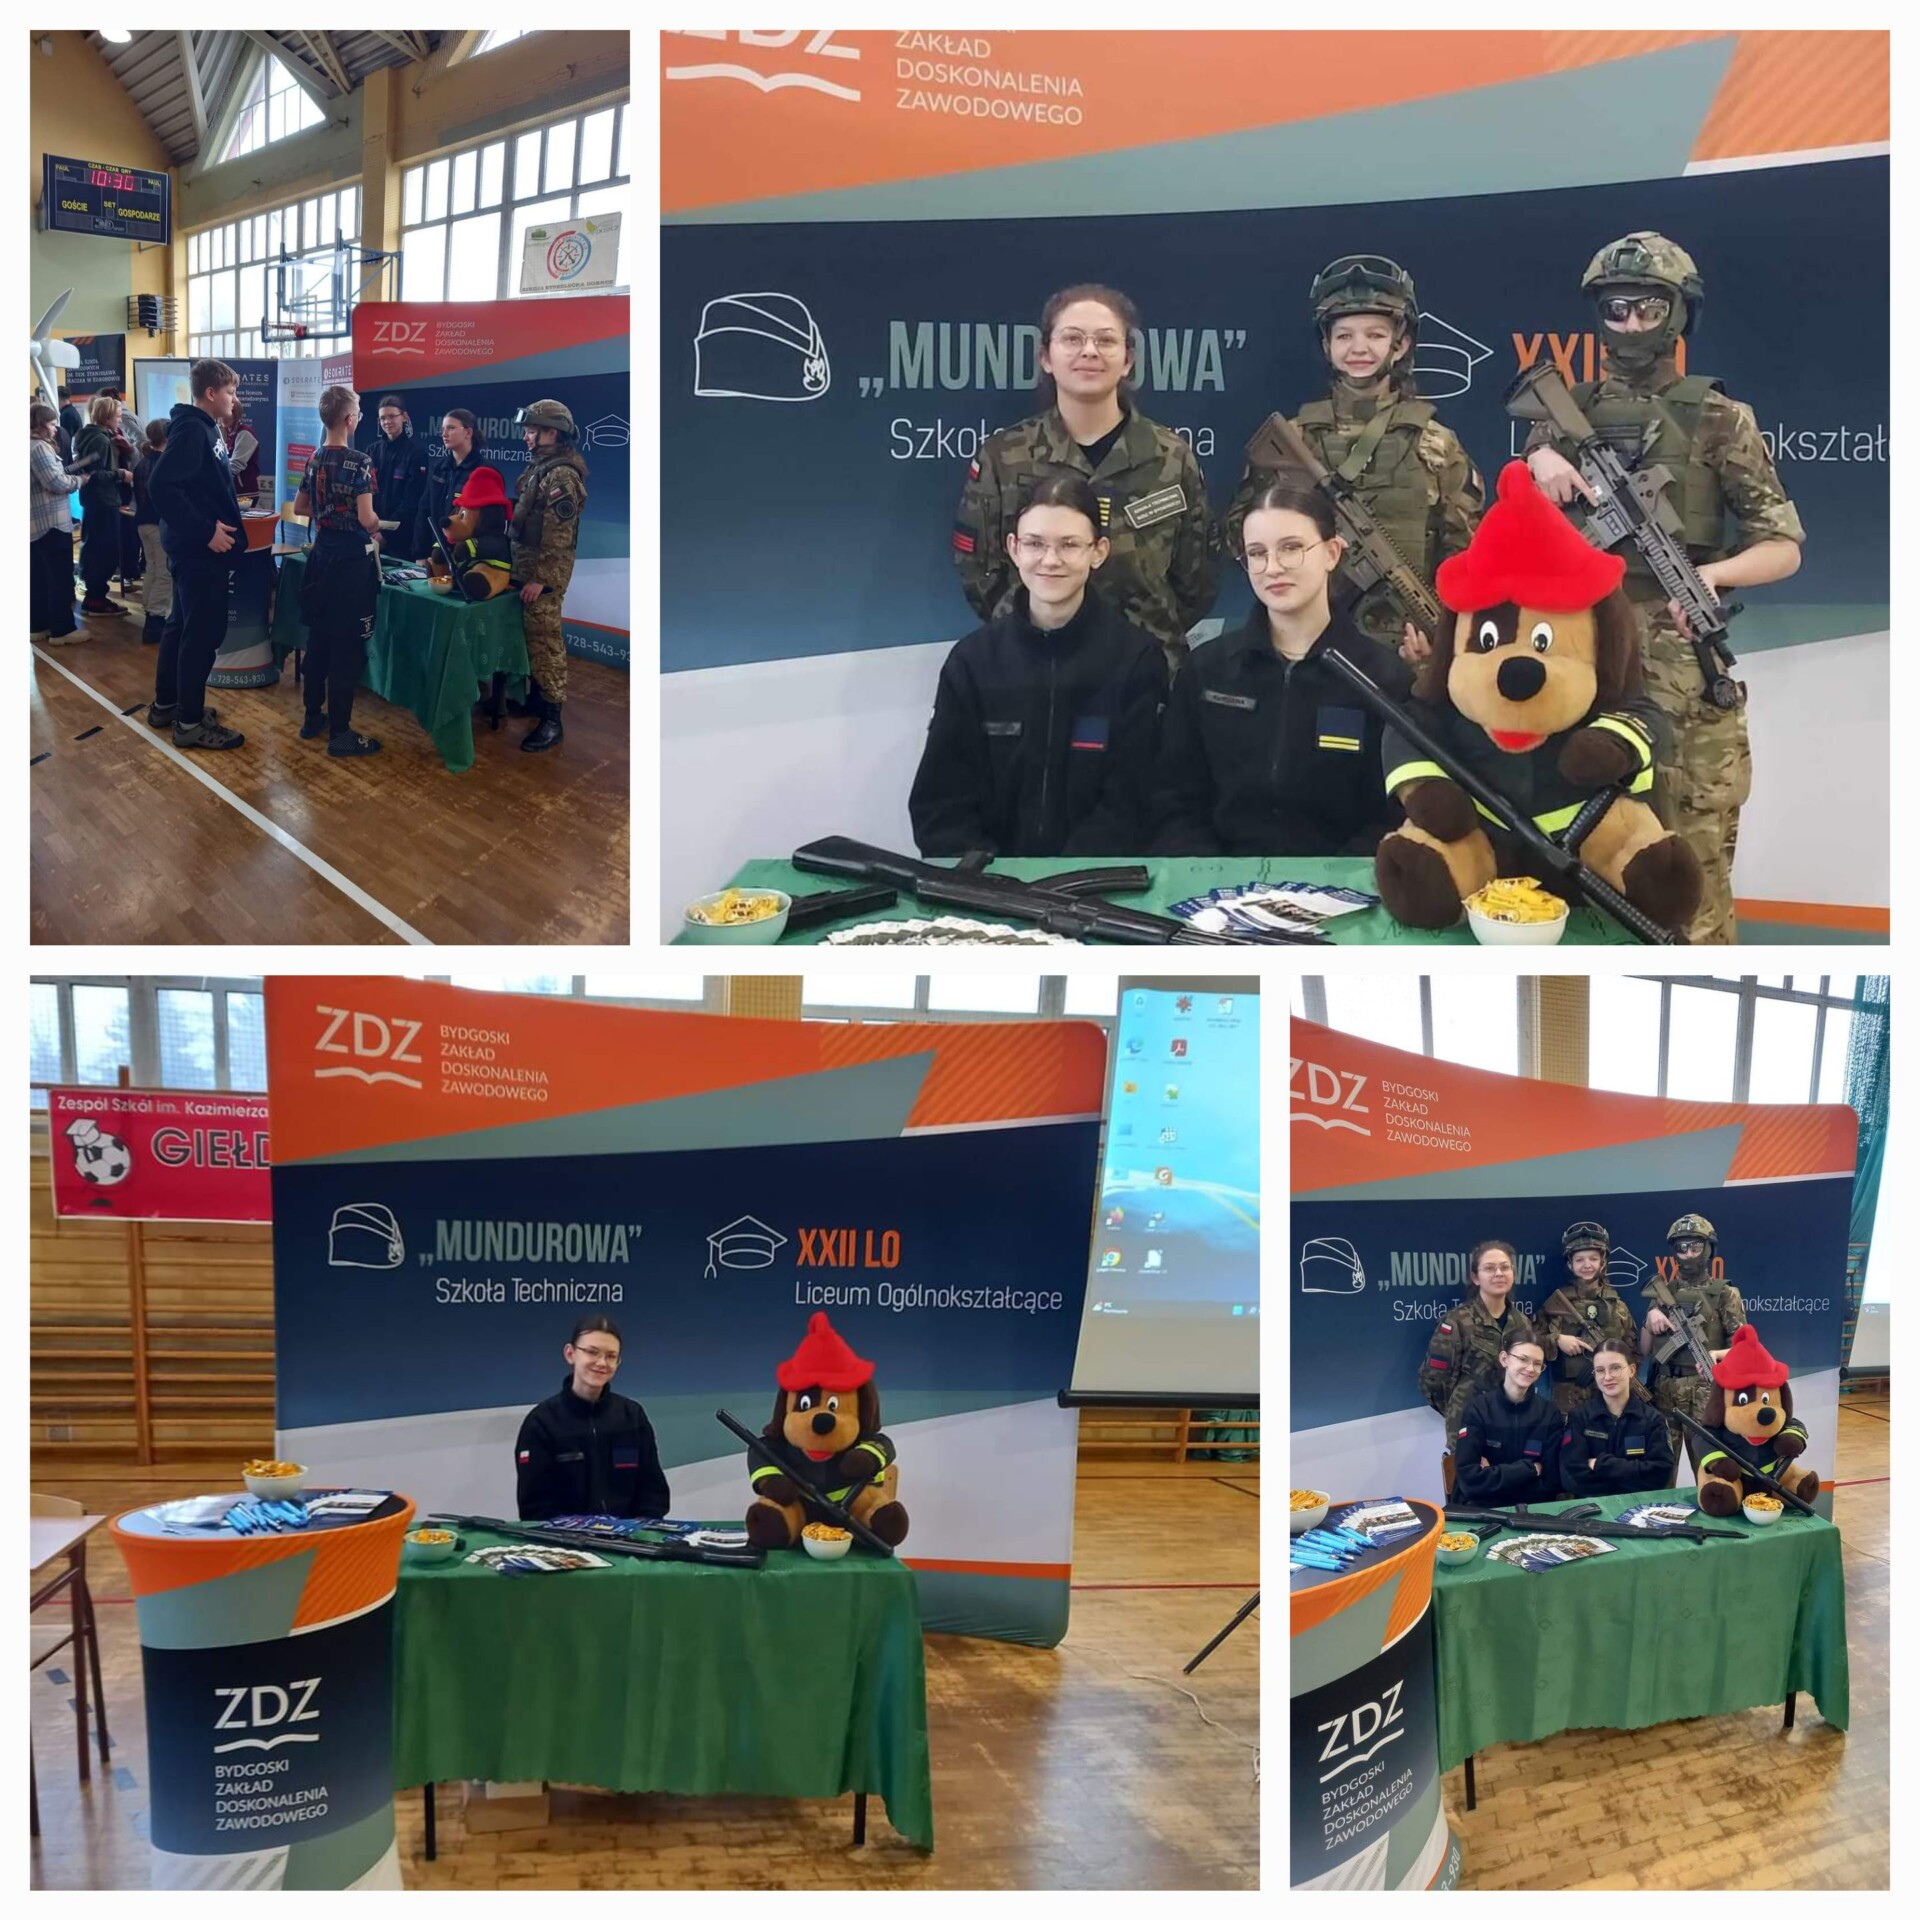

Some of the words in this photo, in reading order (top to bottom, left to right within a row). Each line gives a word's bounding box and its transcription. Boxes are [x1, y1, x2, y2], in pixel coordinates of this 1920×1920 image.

[895, 30, 991, 59] ZAKŁAD
[896, 58, 1083, 97] DOSKONALENIA
[896, 88, 1083, 126] ZAWODOWEGO
[91, 170, 134, 191] 10:30
[61, 199, 88, 212] GOŚCIE
[118, 208, 161, 221] GOSPODARZE
[373, 321, 428, 343] ZDZ
[436, 321, 475, 329] BYDGOSKI
[434, 347, 494, 355] ZAWODOWEGO
[435, 338, 495, 346] DOSKONALENIA
[858, 320, 1247, 399] „MUNDWA”
[1511, 333, 1608, 391] XXI
[238, 374, 269, 382] ATES
[889, 418, 1003, 460] Szkoł
[480, 447, 532, 462] chniczna
[218, 674, 266, 684] 728-543-930
[314, 1004, 423, 1064] ZDZ
[440, 1025, 510, 1046] BYDGOSKI
[440, 1043, 496, 1061] ZAKŁAD
[441, 1061, 549, 1085] DOSKONALENIA
[1290, 1056, 1369, 1114] ZDZ
[441, 1079, 548, 1102] ZAWODOWEGO
[1382, 1080, 1439, 1103] BYDGOSKI
[156, 1100, 180, 1114] im.
[185, 1101, 269, 1119] Kazimierza
[1383, 1096, 1429, 1115] ZAKŁAD
[1385, 1112, 1471, 1137] DOSKONALENIA
[152, 1127, 270, 1170] GIEŁD
[1386, 1129, 1472, 1152] ZAWODOWEGO
[419, 1219, 642, 1267] „MUNDUROWA”
[796, 1228, 856, 1267] XXII
[863, 1230, 900, 1269] LO
[1378, 1251, 1546, 1292] „MUNDUA”
[435, 1277, 506, 1303] Szkoła
[511, 1277, 623, 1303] Techniczna
[795, 1281, 871, 1306] Liceum
[877, 1282, 1063, 1315] Ogólnokształcące
[1393, 1300, 1448, 1322] Szkoła
[214, 1677, 322, 1730] ZDZ
[1317, 1679, 1404, 1763] ZDZ
[214, 1759, 290, 1779] BYDGOSKI
[215, 1779, 274, 1796] ZAKŁAD
[1321, 1760, 1385, 1805] BYDGOSKI
[215, 1786, 328, 1814] DOSKONALENIA
[1322, 1785, 1374, 1821] ZAKŁAD
[1324, 1768, 1413, 1836] DOSKONALENIA
[215, 1803, 328, 1831] ZAWODOWEGO
[1325, 1782, 1413, 1851] ZAWODOWEGO
